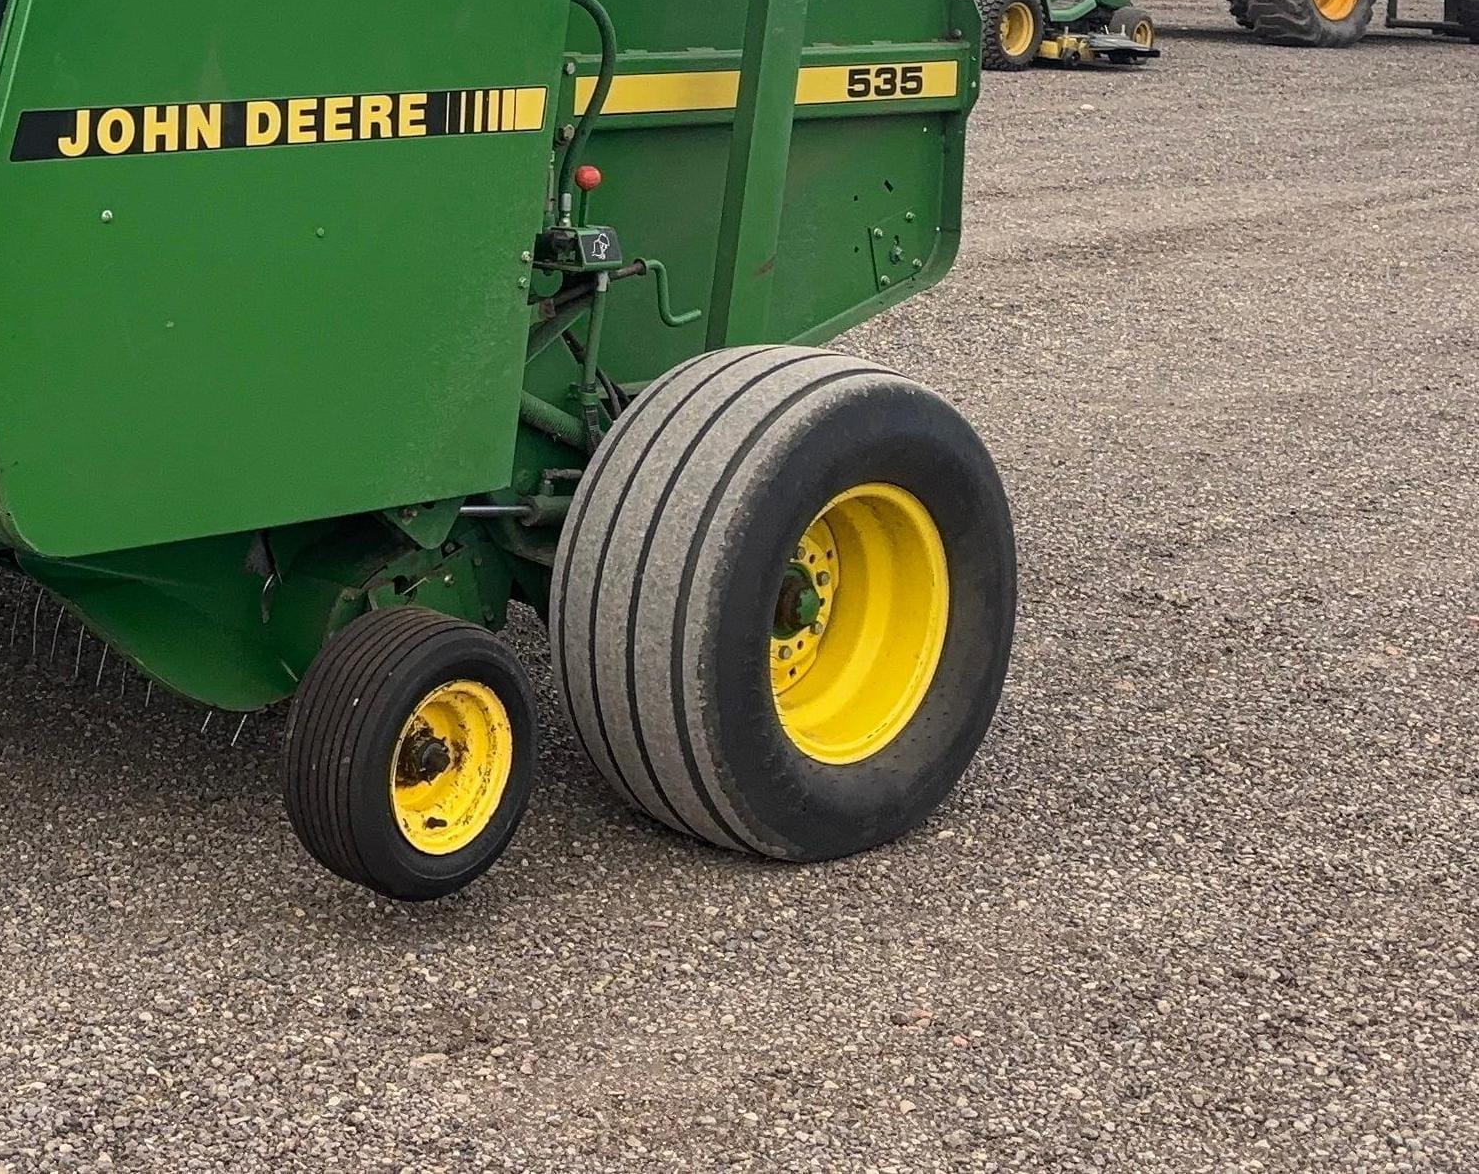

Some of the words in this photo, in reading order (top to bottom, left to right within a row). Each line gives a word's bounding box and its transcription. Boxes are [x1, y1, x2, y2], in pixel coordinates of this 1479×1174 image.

[847, 66, 923, 98] 535
[57, 103, 222, 157] JOHN
[245, 93, 428, 147] DEERE
